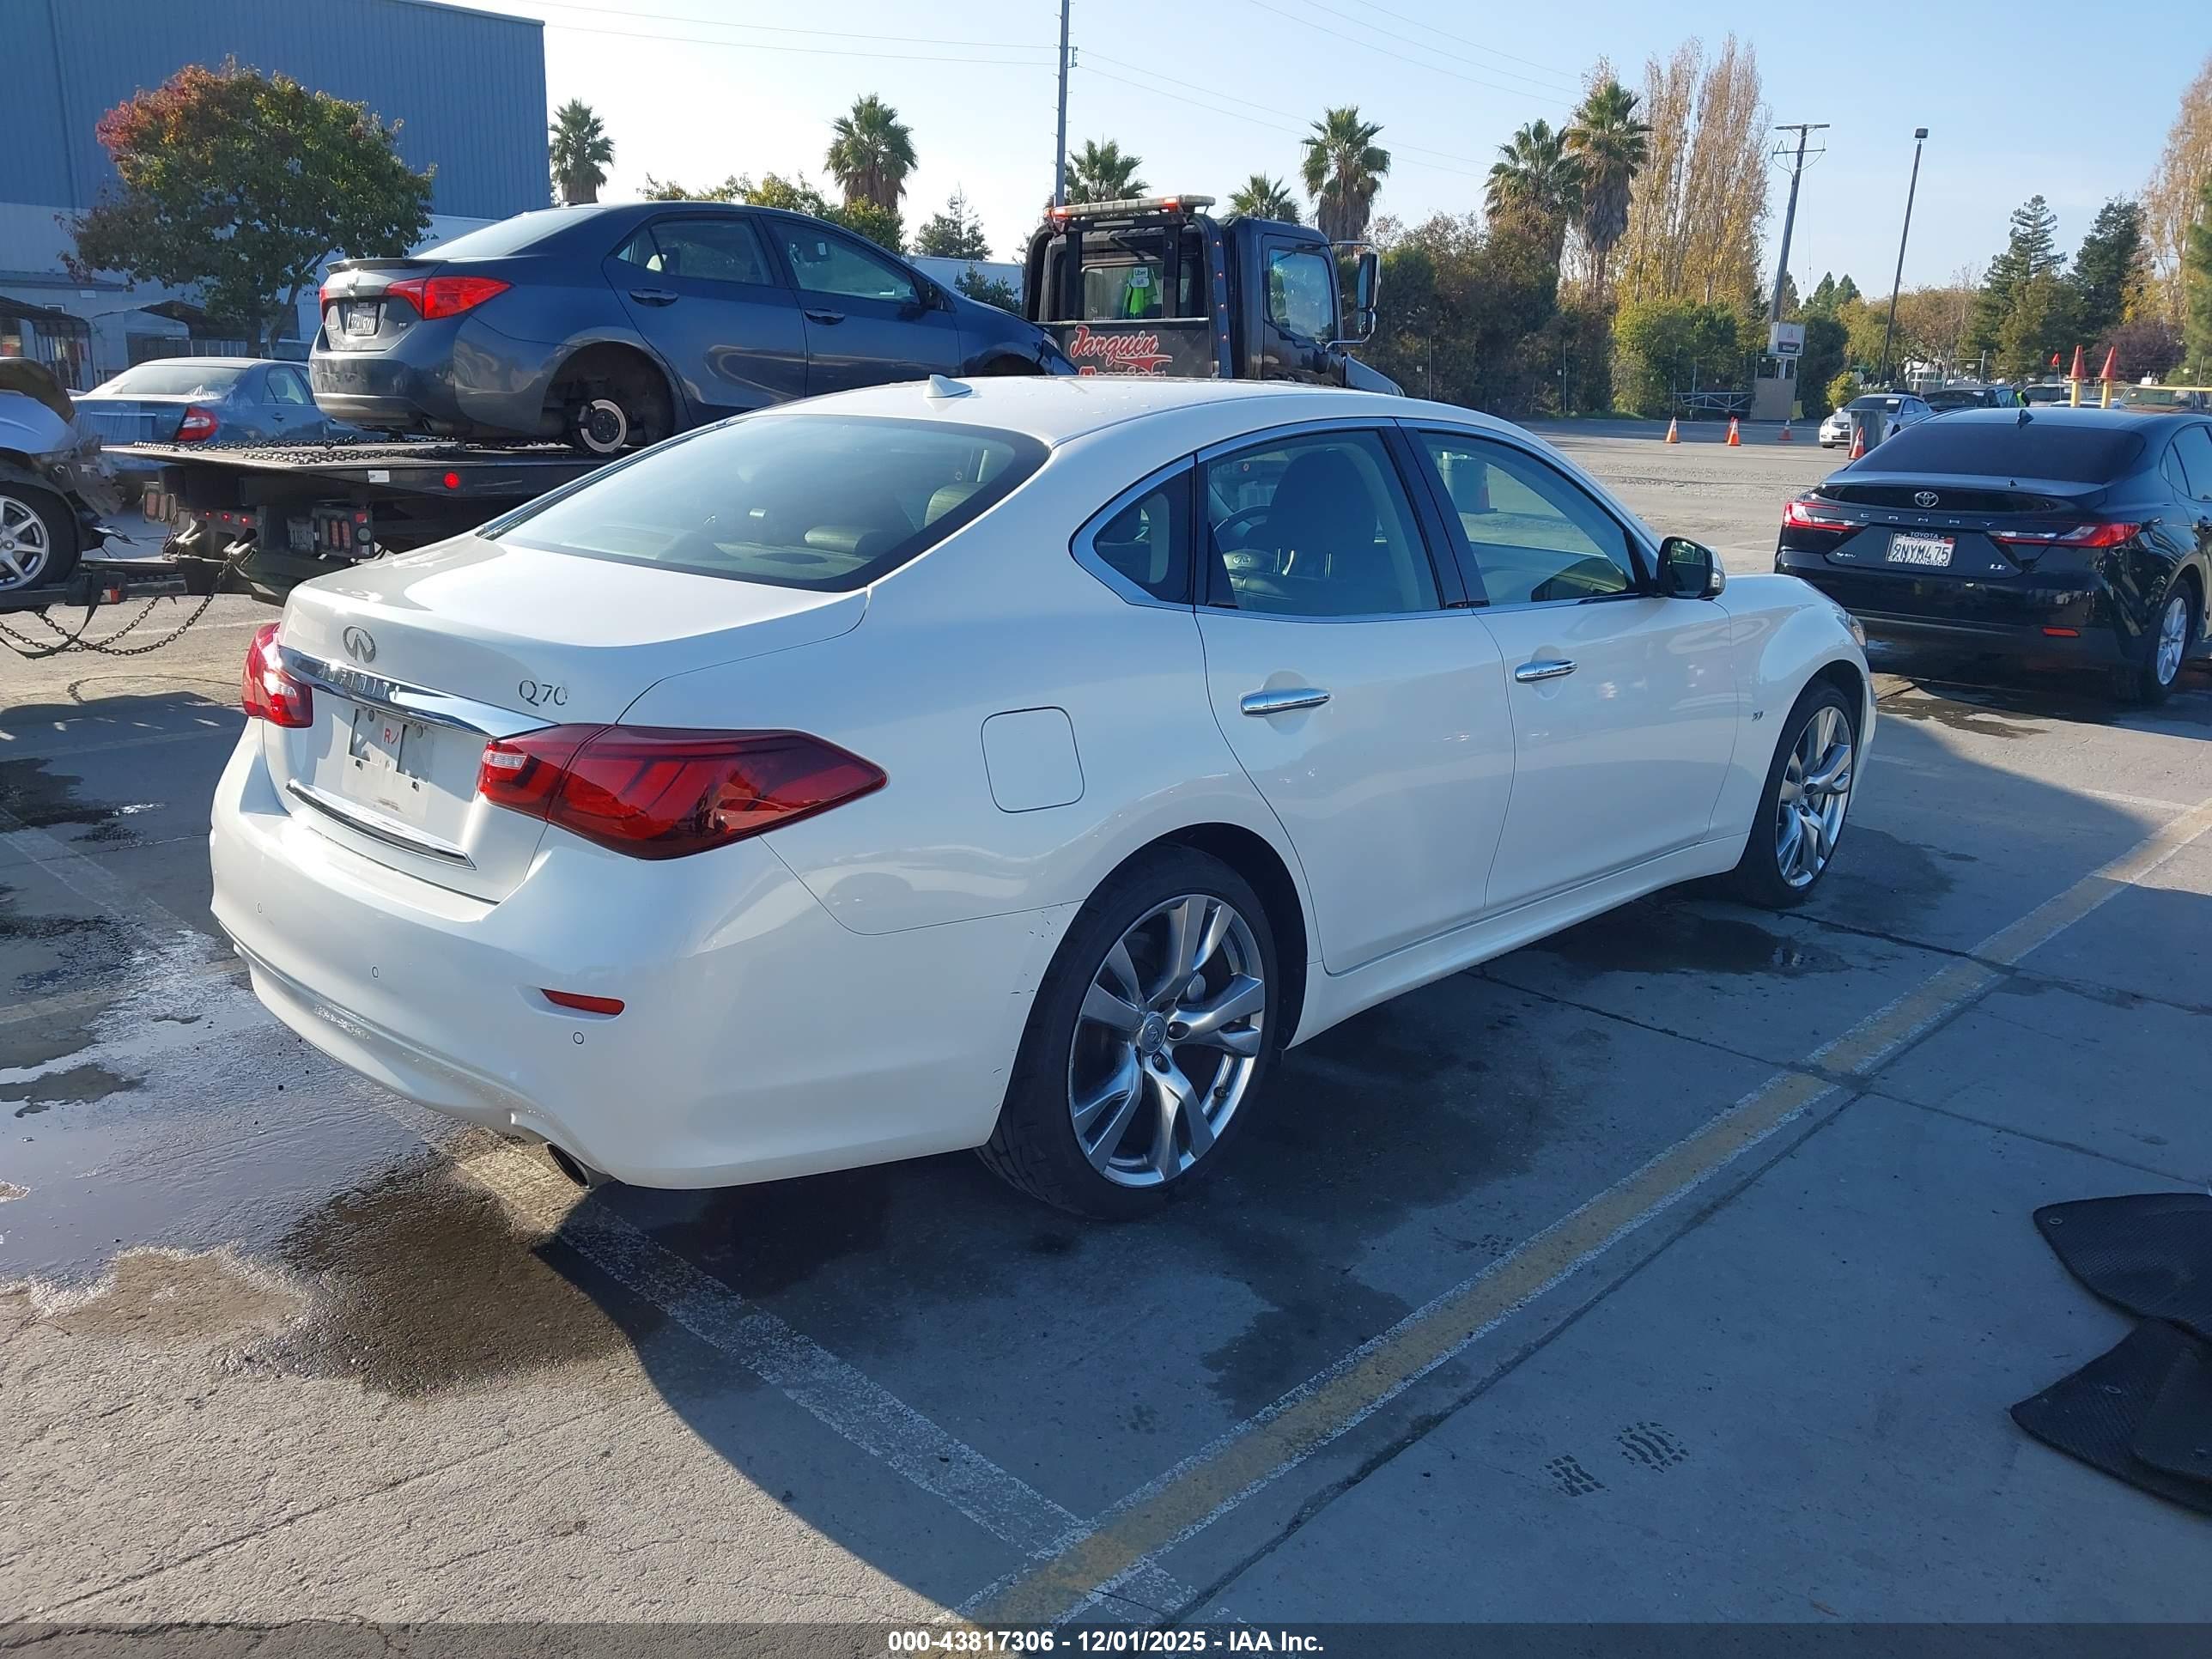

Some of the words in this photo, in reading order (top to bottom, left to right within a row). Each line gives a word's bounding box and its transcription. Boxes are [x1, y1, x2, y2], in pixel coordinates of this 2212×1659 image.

[1070, 325, 1159, 367] Jarquin
[1910, 531, 1939, 539] TOYOTA
[1891, 543, 1950, 562] 9NYM475
[1905, 557, 1949, 567] FRANCISCO
[519, 680, 568, 707] Q70
